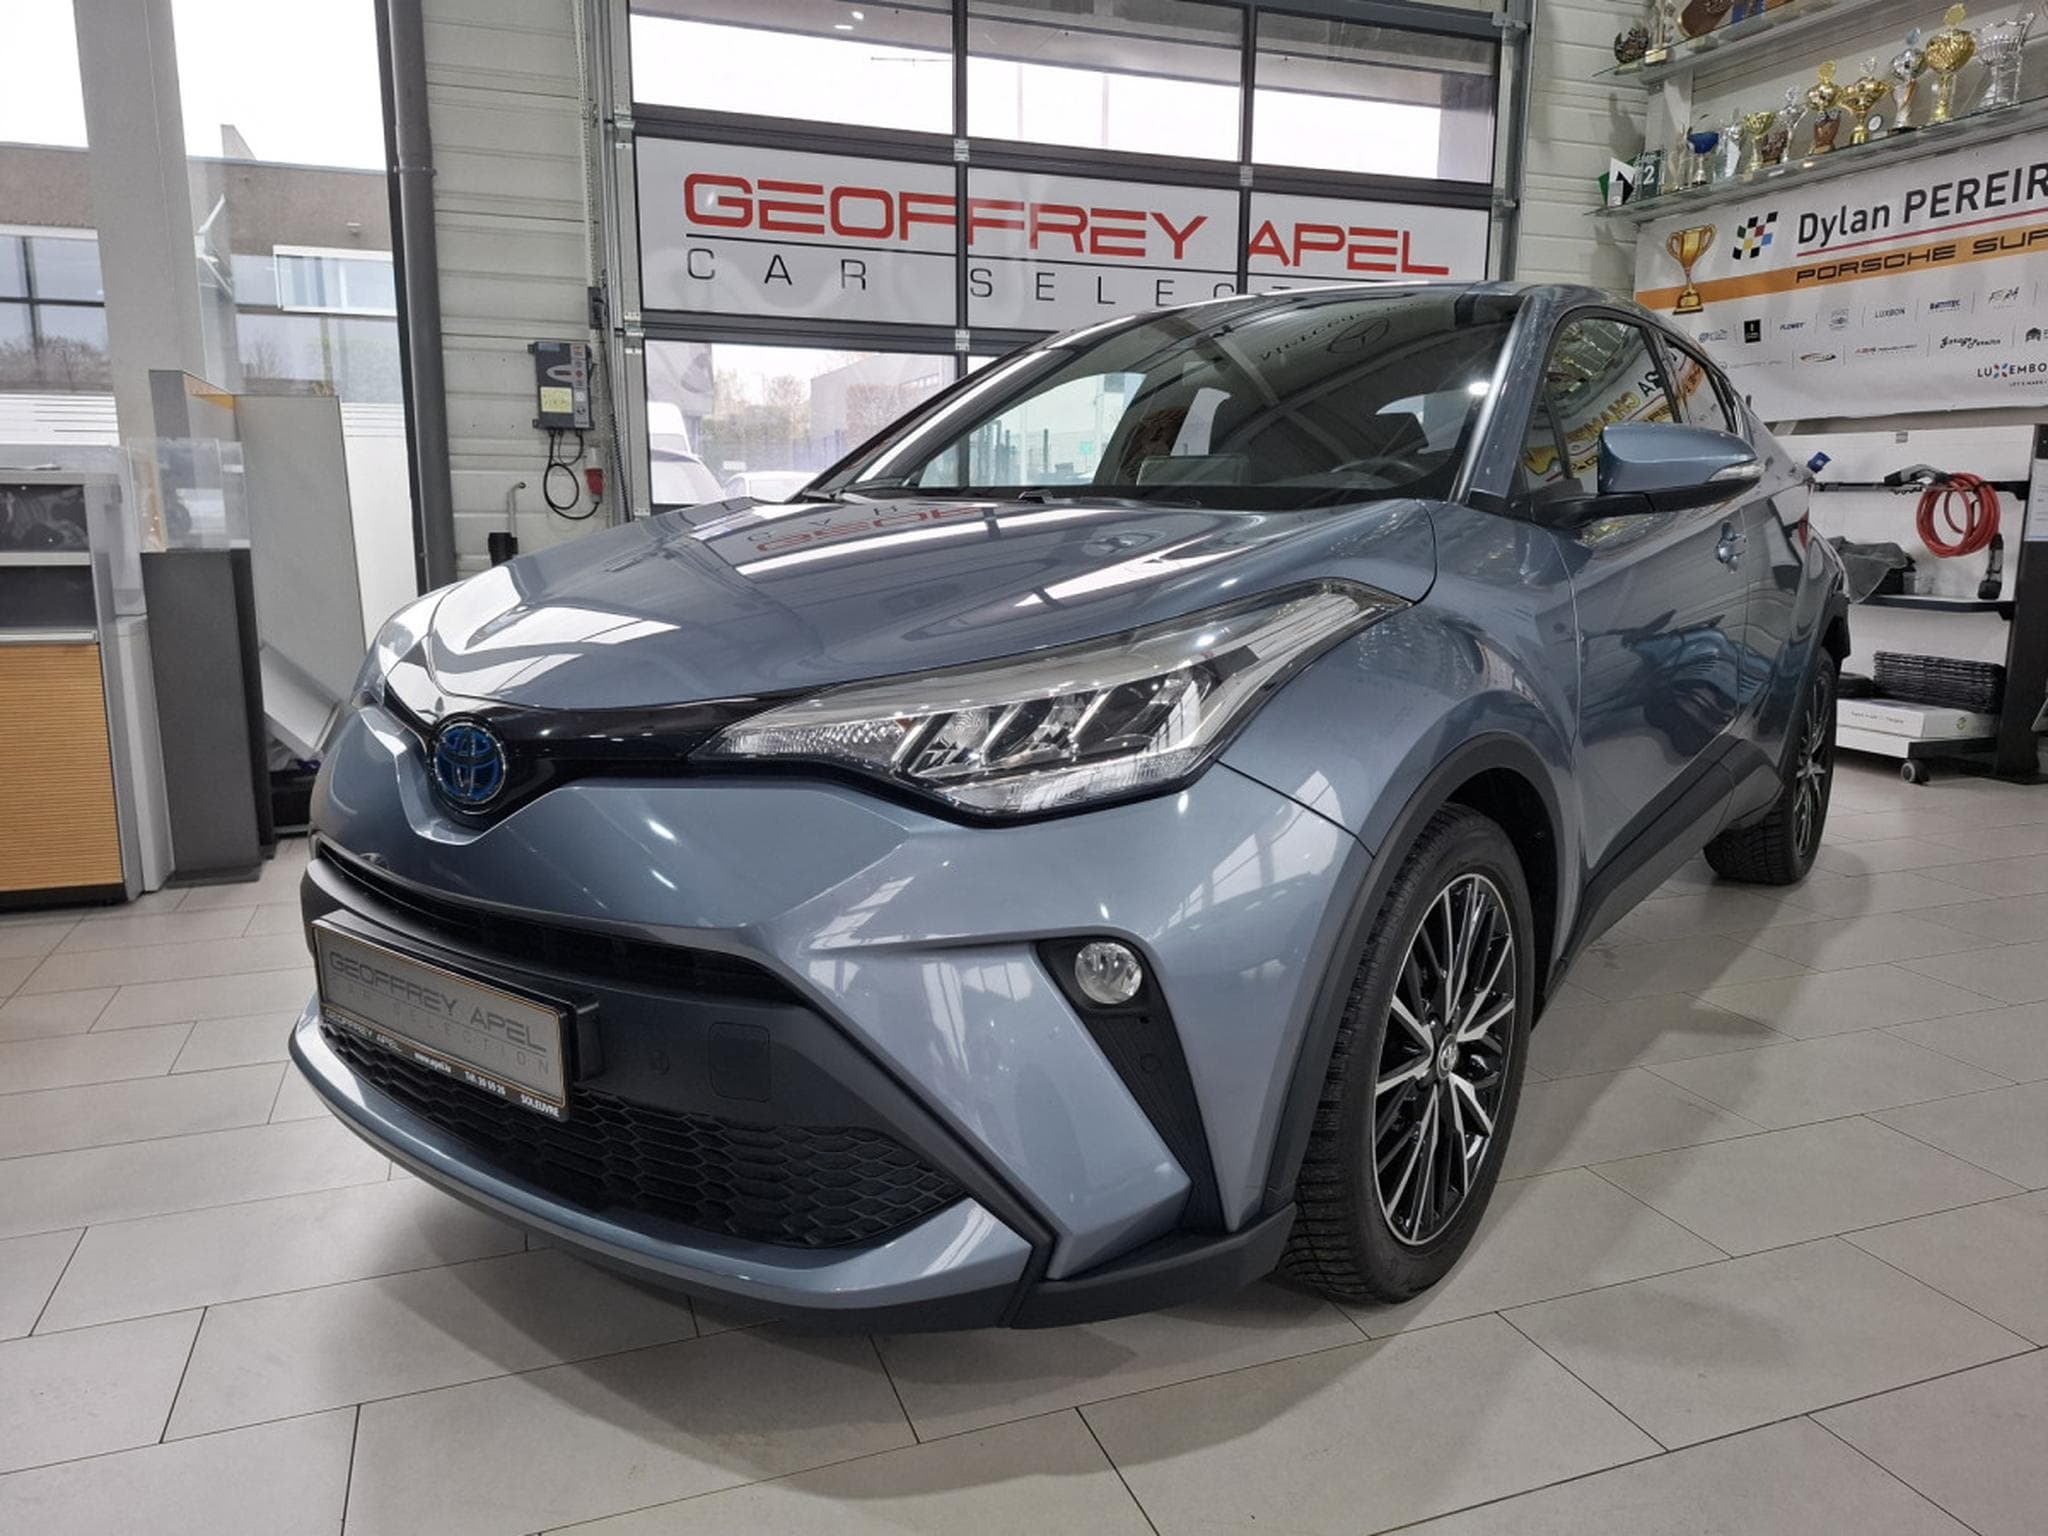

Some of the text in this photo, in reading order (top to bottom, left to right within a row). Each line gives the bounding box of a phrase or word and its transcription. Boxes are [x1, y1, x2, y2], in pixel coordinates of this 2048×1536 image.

[684, 173, 1450, 276] GEOFFREY APEL
[1797, 162, 2048, 247] Dylan PEREIR
[686, 248, 867, 291] CAR
[1796, 244, 1956, 284] PORSCHE
[329, 950, 547, 1053] GEOFFREY APEL
